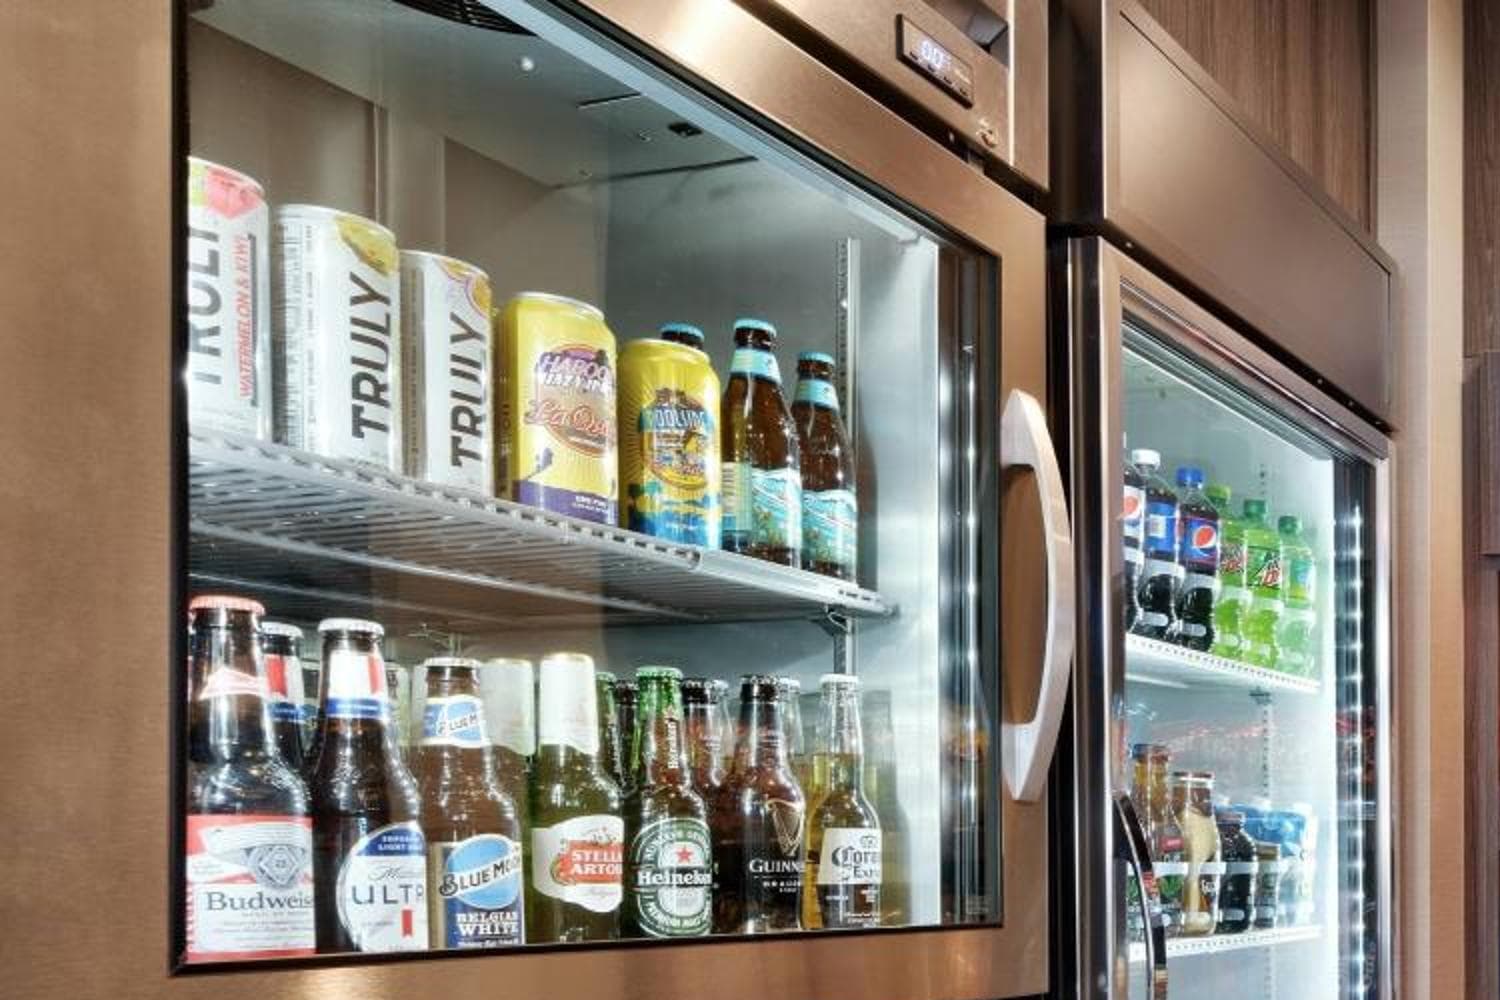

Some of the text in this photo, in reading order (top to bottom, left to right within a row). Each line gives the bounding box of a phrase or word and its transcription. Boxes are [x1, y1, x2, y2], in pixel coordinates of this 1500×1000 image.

[350, 271, 391, 439] TRULY
[450, 311, 484, 468] TRULY
[440, 853, 521, 897] BLUE MOO
[750, 858, 805, 874] GUINN
[205, 890, 315, 912] Budweis
[456, 922, 519, 938] WHITE
